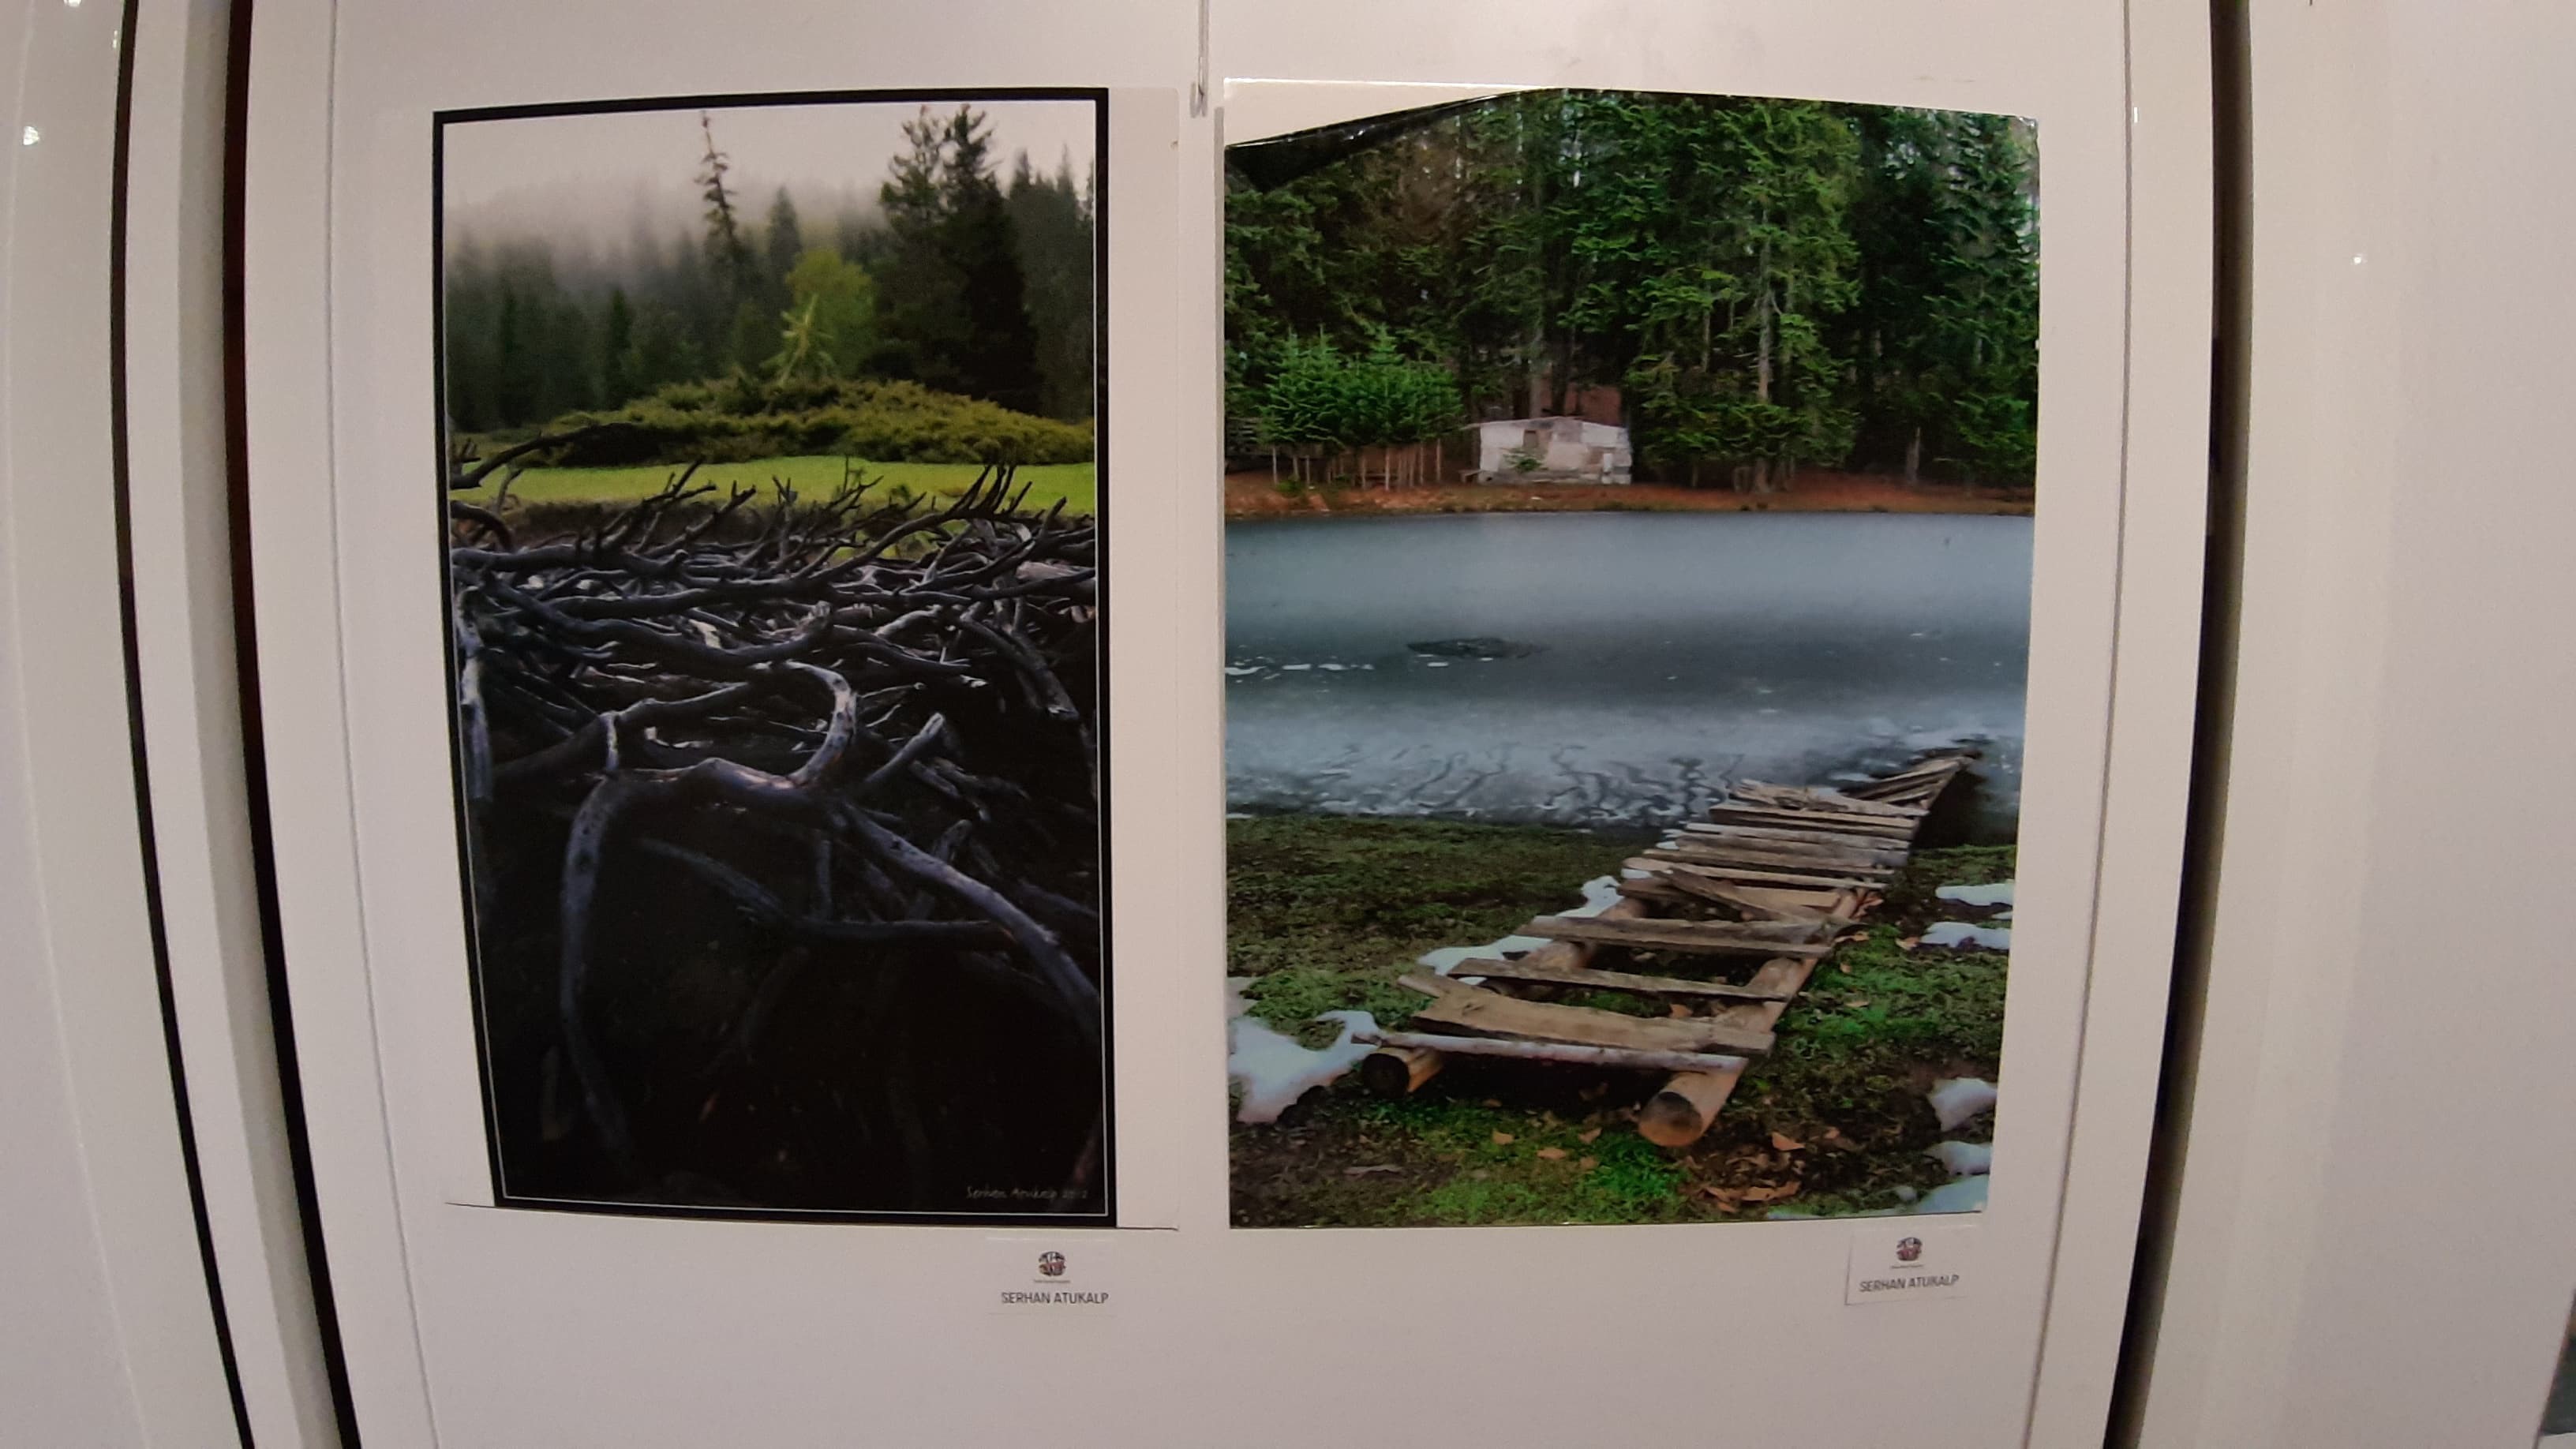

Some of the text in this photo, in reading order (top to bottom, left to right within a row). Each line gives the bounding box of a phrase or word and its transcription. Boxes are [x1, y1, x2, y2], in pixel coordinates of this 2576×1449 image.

[1859, 1274, 1960, 1293] SERHAN ATUKALP
[1002, 1292, 1109, 1304] SERHAN ATUKALP
